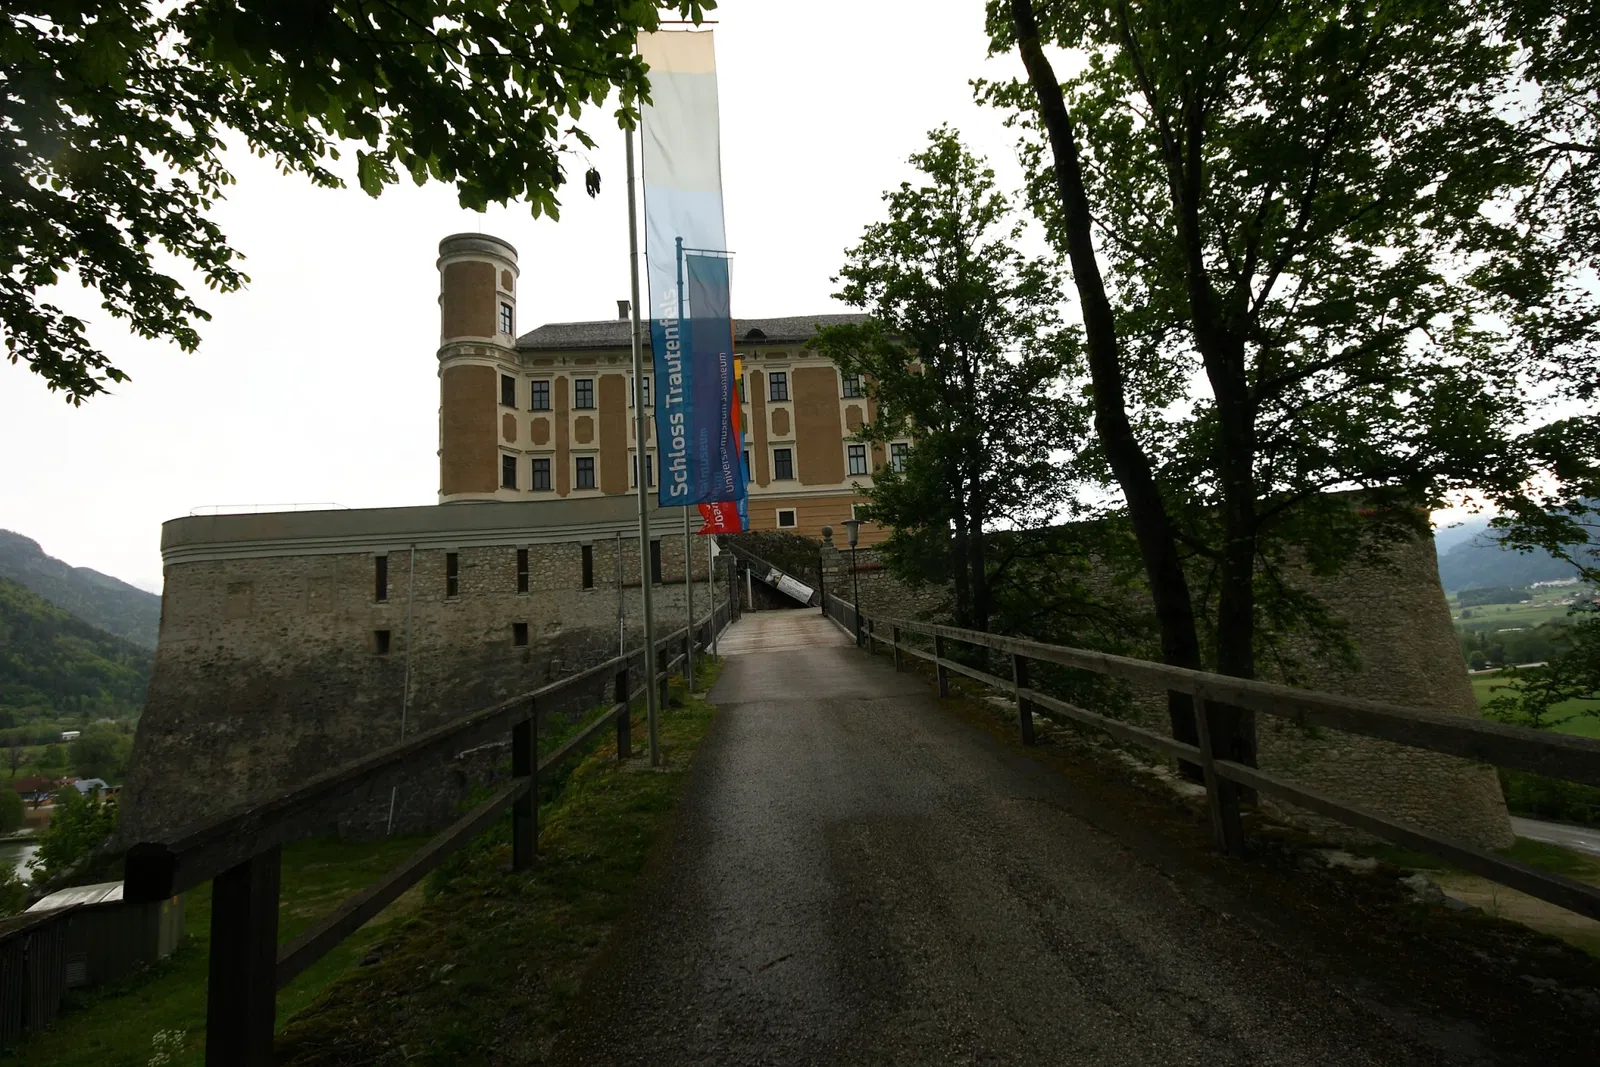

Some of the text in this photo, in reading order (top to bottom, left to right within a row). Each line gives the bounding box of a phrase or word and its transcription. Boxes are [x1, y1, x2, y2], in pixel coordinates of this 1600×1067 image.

[659, 289, 688, 497] Schloss Trautenfels
[718, 352, 735, 493] Universalmuseum Joanneum
